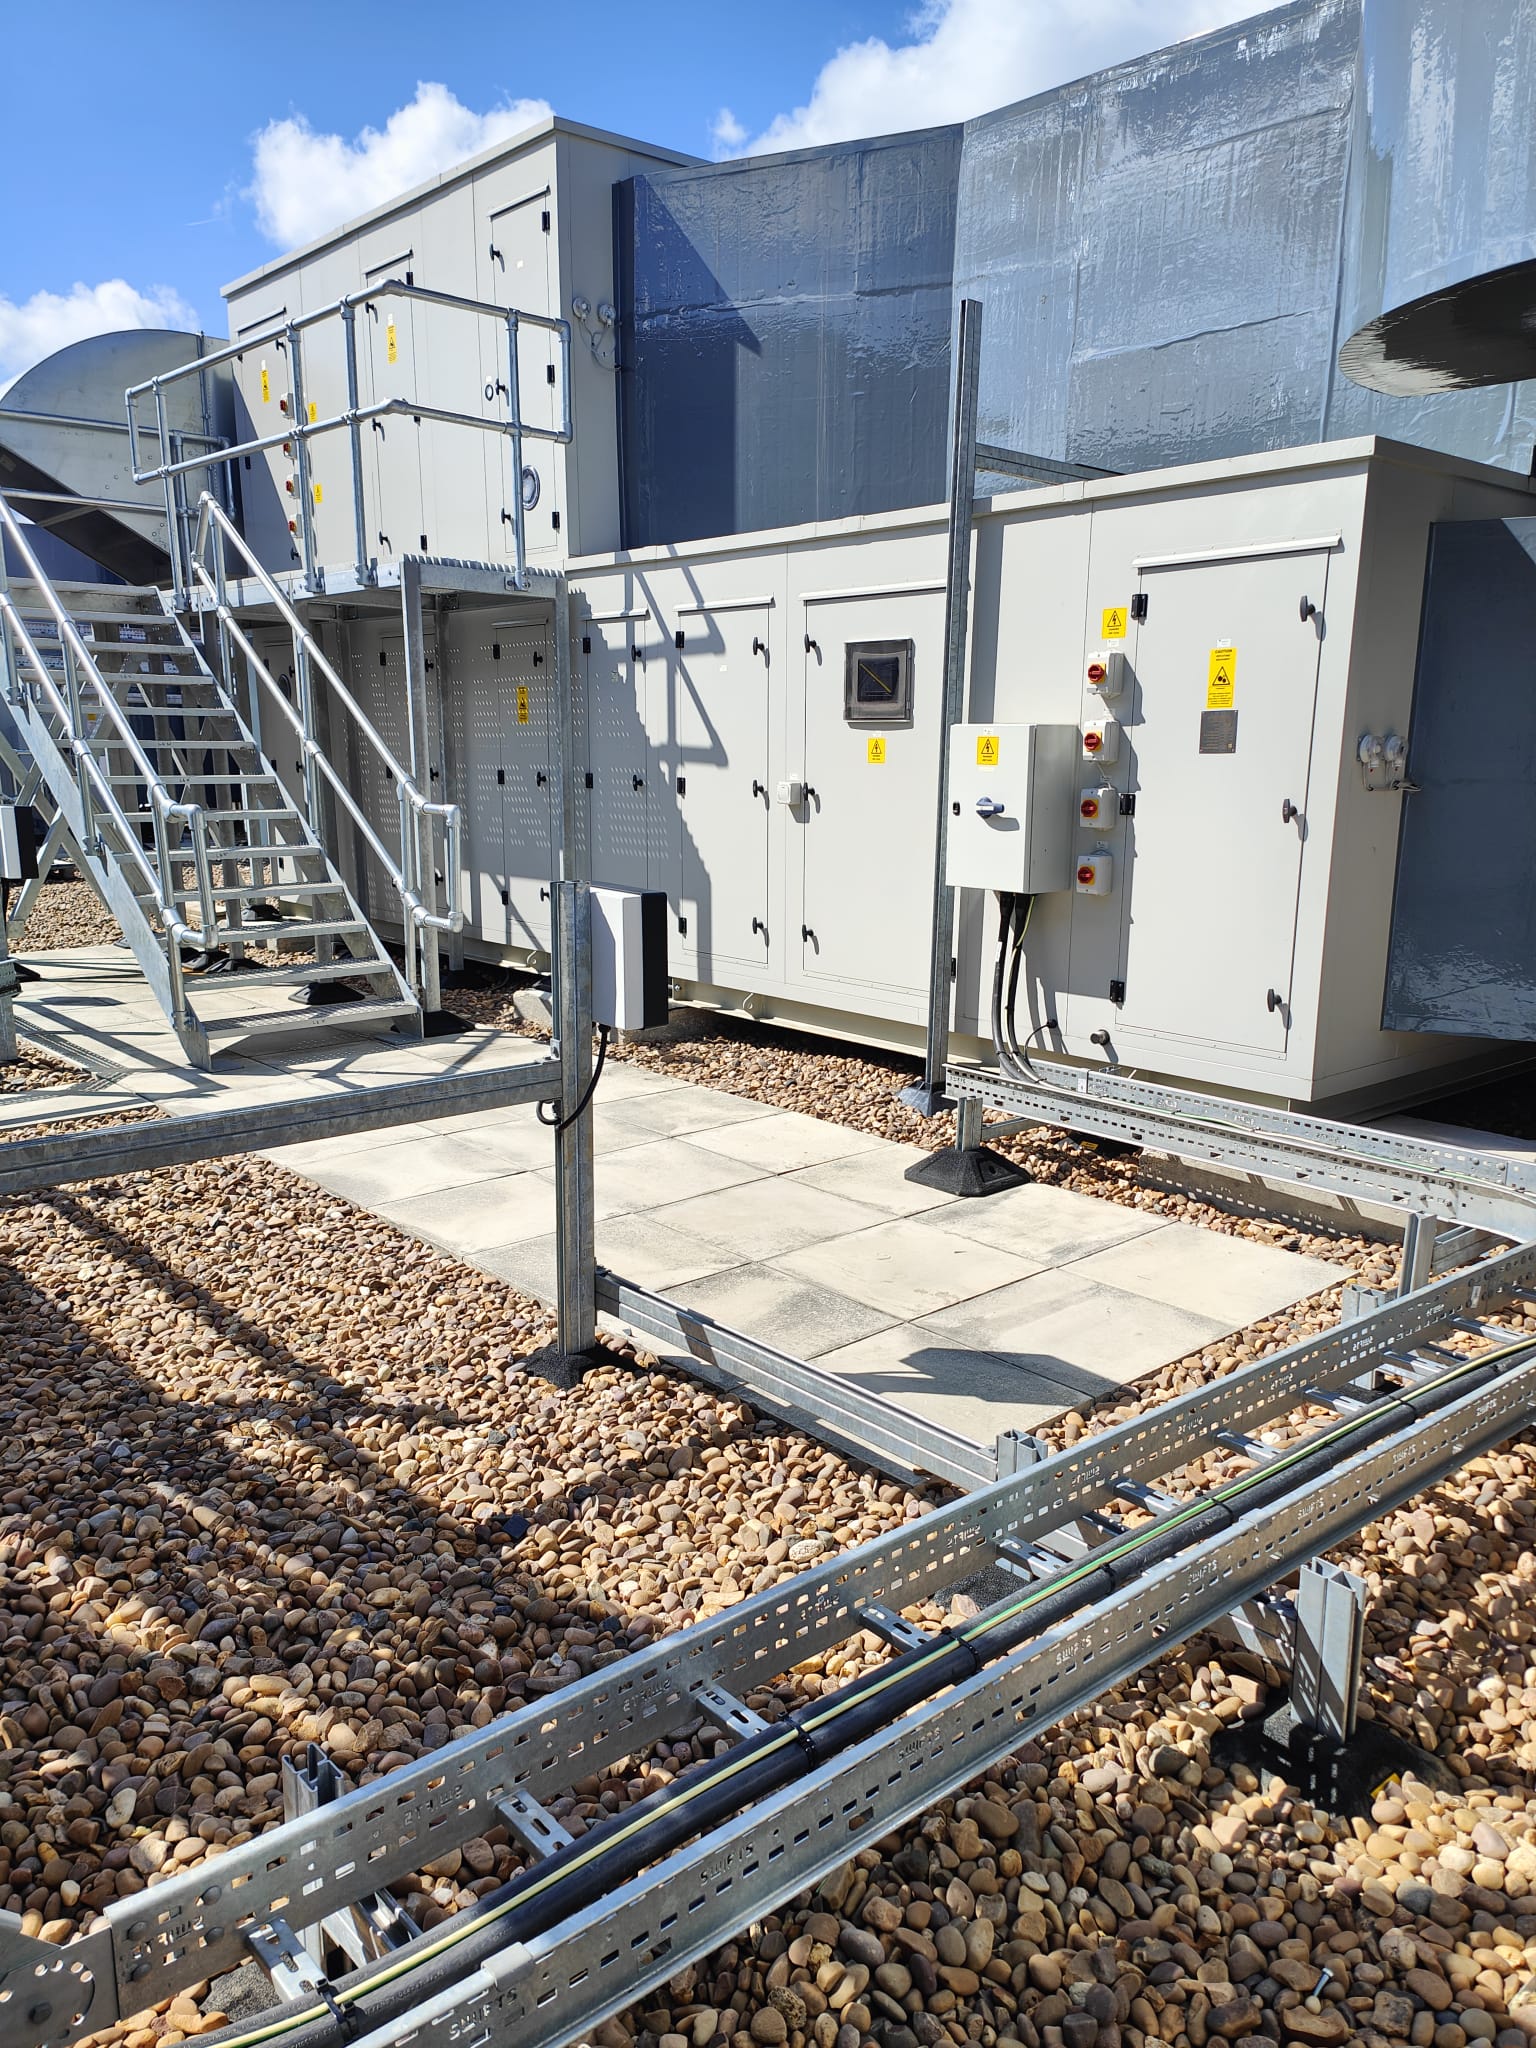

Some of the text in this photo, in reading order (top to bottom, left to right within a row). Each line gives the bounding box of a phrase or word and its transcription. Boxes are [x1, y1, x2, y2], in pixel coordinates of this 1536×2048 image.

[1297, 1497, 1324, 1521] SWIFTS
[1187, 1559, 1218, 1586] SWIFTS
[898, 1727, 941, 1762] SWIFTS
[700, 1843, 754, 1887] SWIFTS
[449, 1987, 518, 2041] SWIFTS
